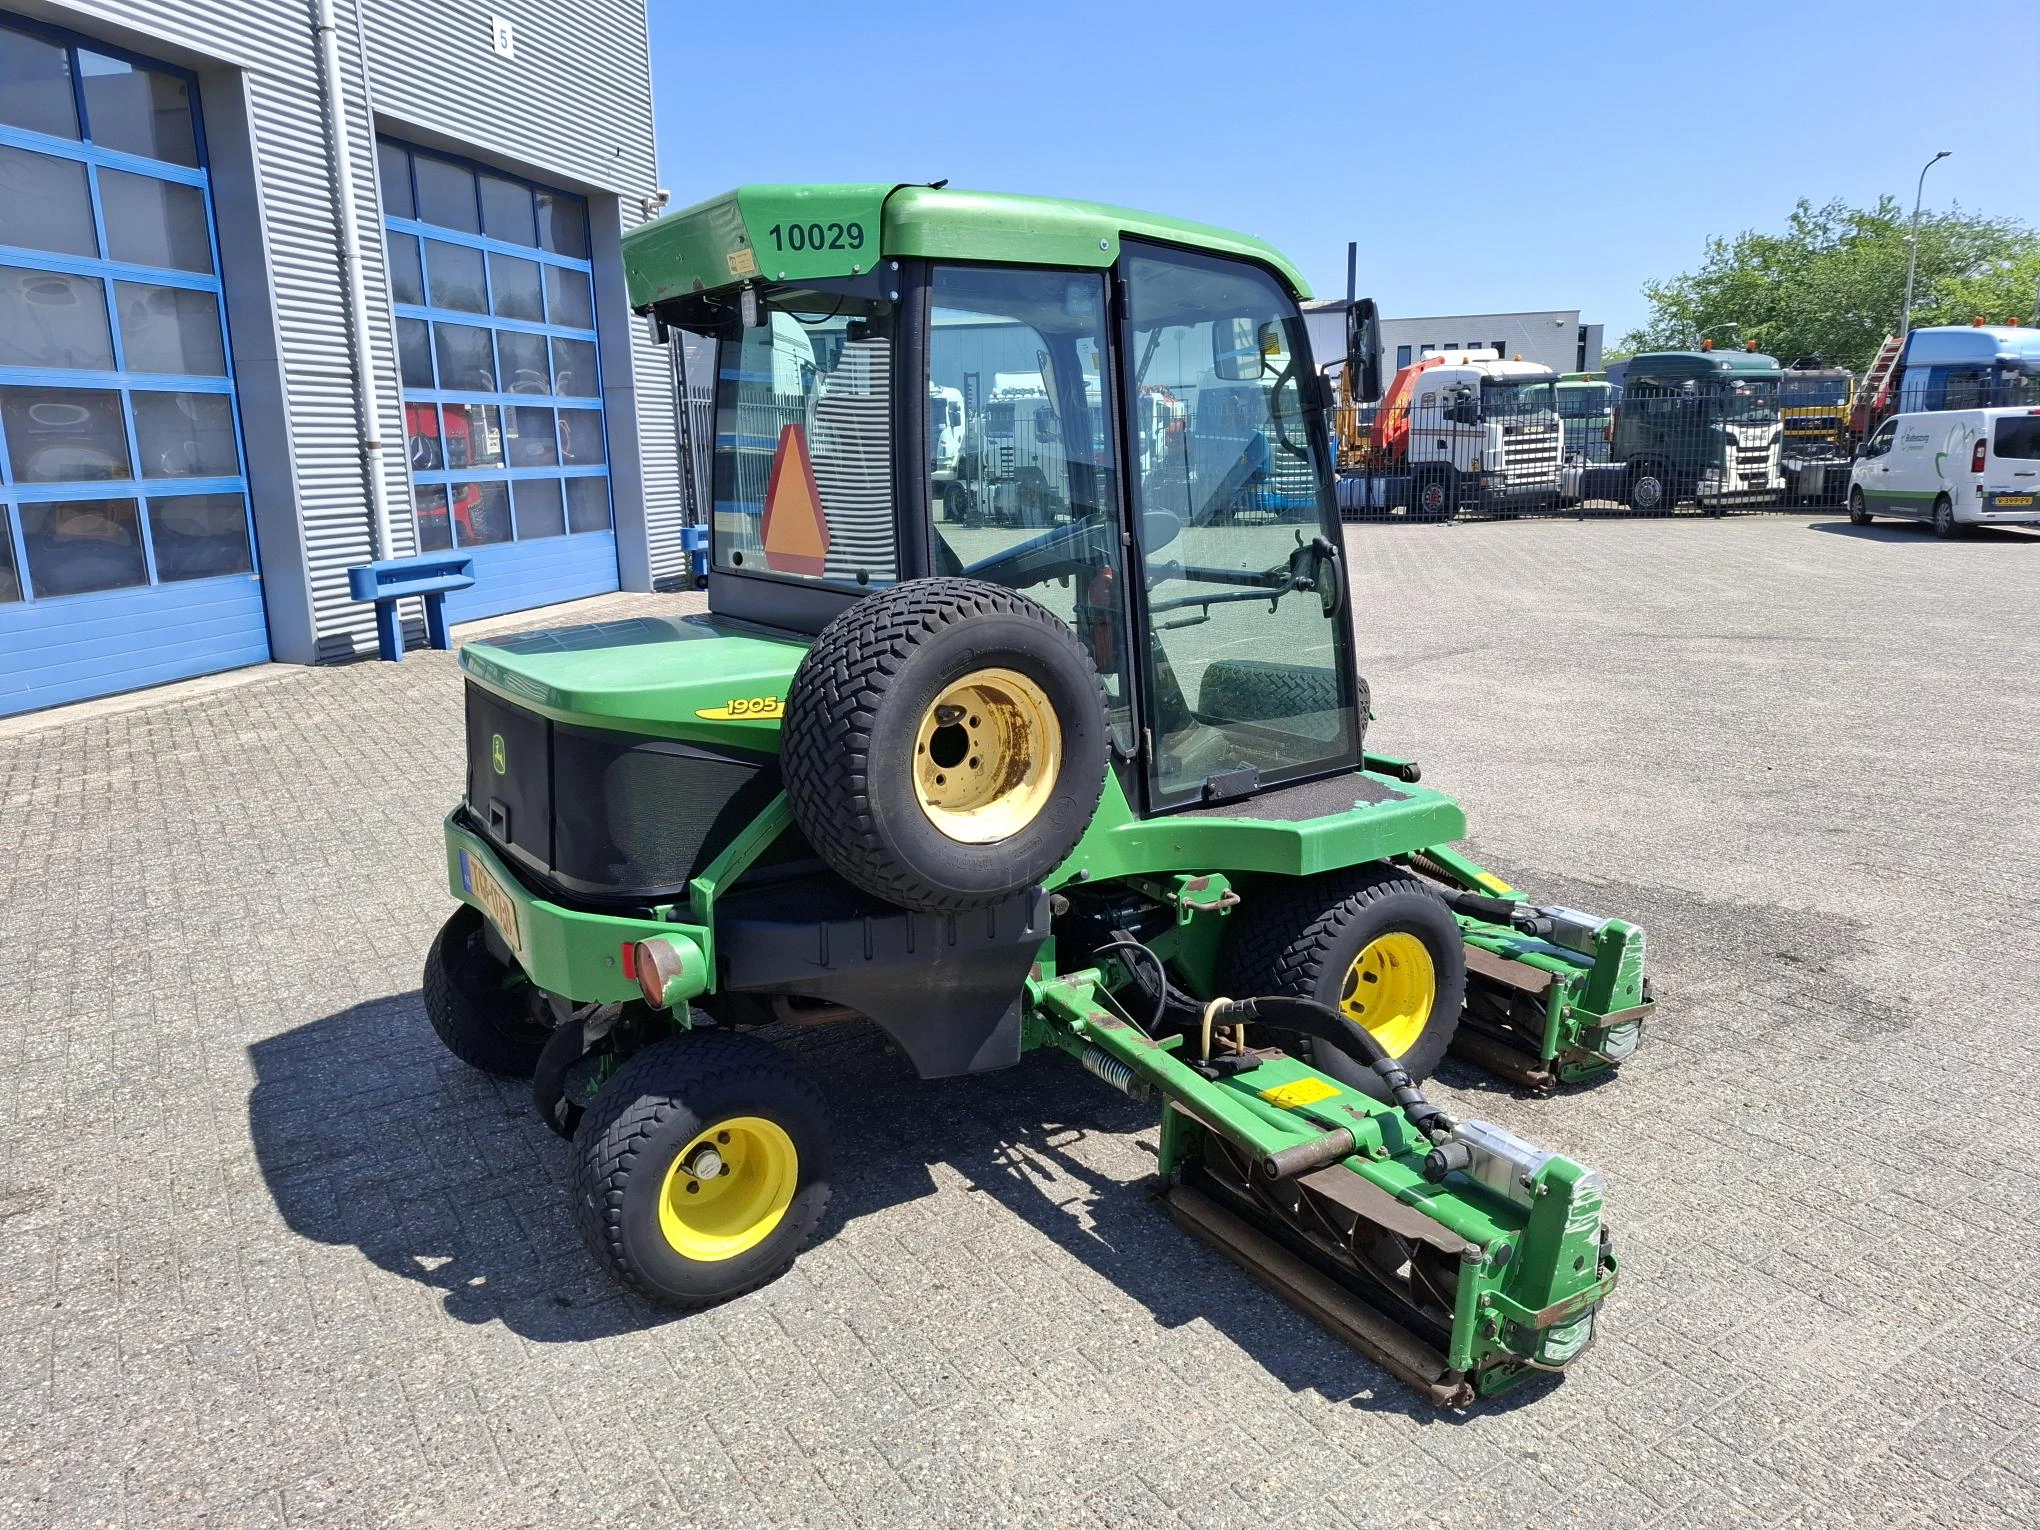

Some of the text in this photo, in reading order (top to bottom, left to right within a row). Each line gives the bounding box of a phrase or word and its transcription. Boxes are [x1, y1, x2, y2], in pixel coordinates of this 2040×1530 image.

[500, 29, 508, 49] 5
[769, 222, 865, 251] 10029
[727, 696, 778, 715] 1905
